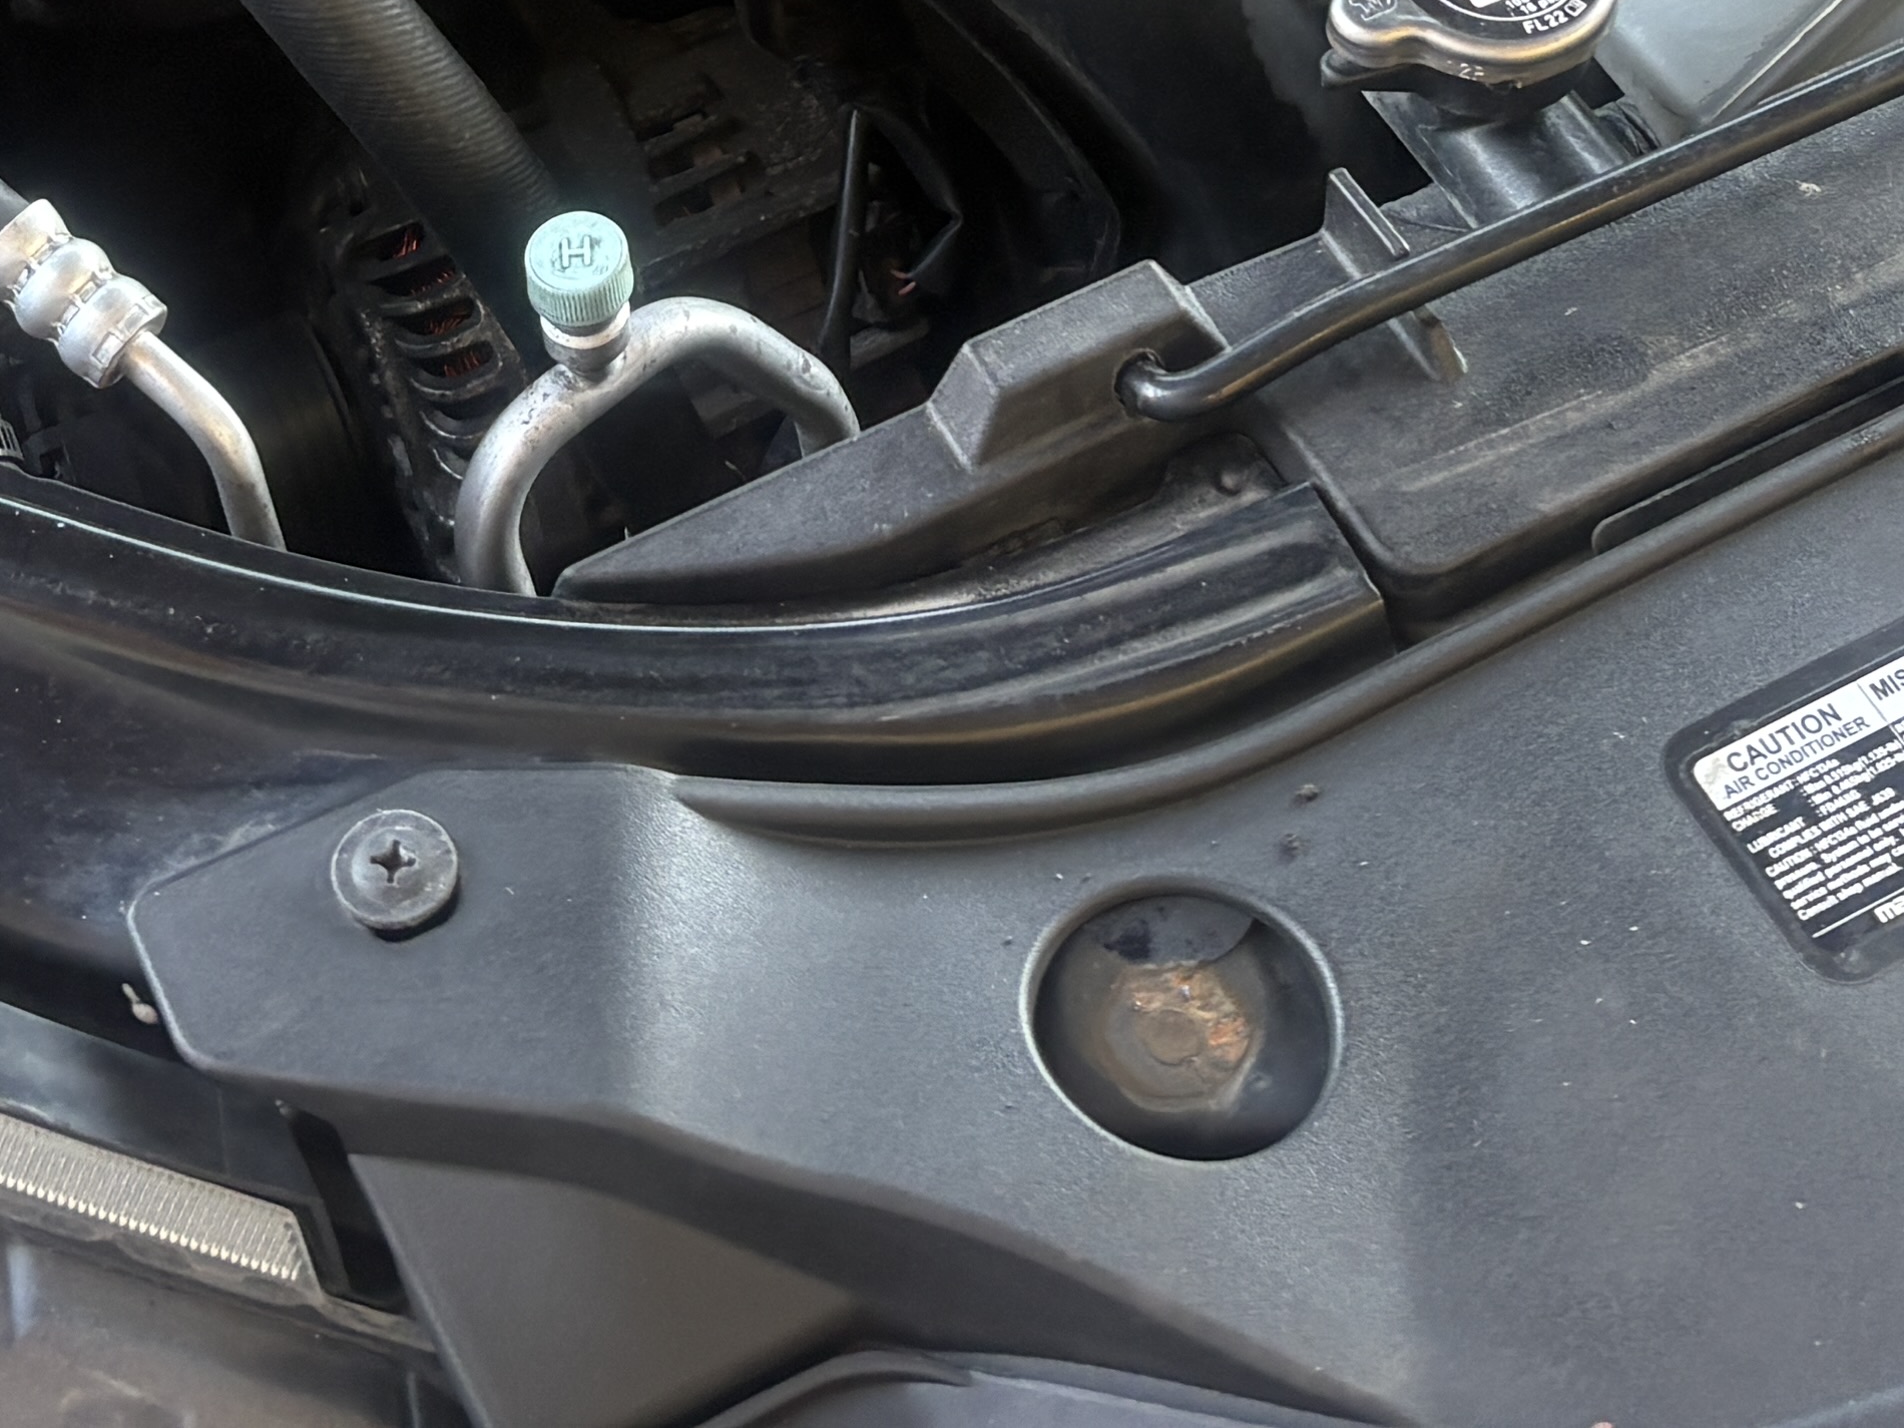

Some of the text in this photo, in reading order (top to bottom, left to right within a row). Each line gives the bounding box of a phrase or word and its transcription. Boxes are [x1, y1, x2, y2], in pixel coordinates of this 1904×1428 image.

[1520, 1, 1538, 15] 16
[1521, 10, 1569, 35] FL22
[559, 233, 594, 269] H
[1727, 703, 1841, 771] CAUTION
[1725, 717, 1869, 797] AIR CONDITIONER
